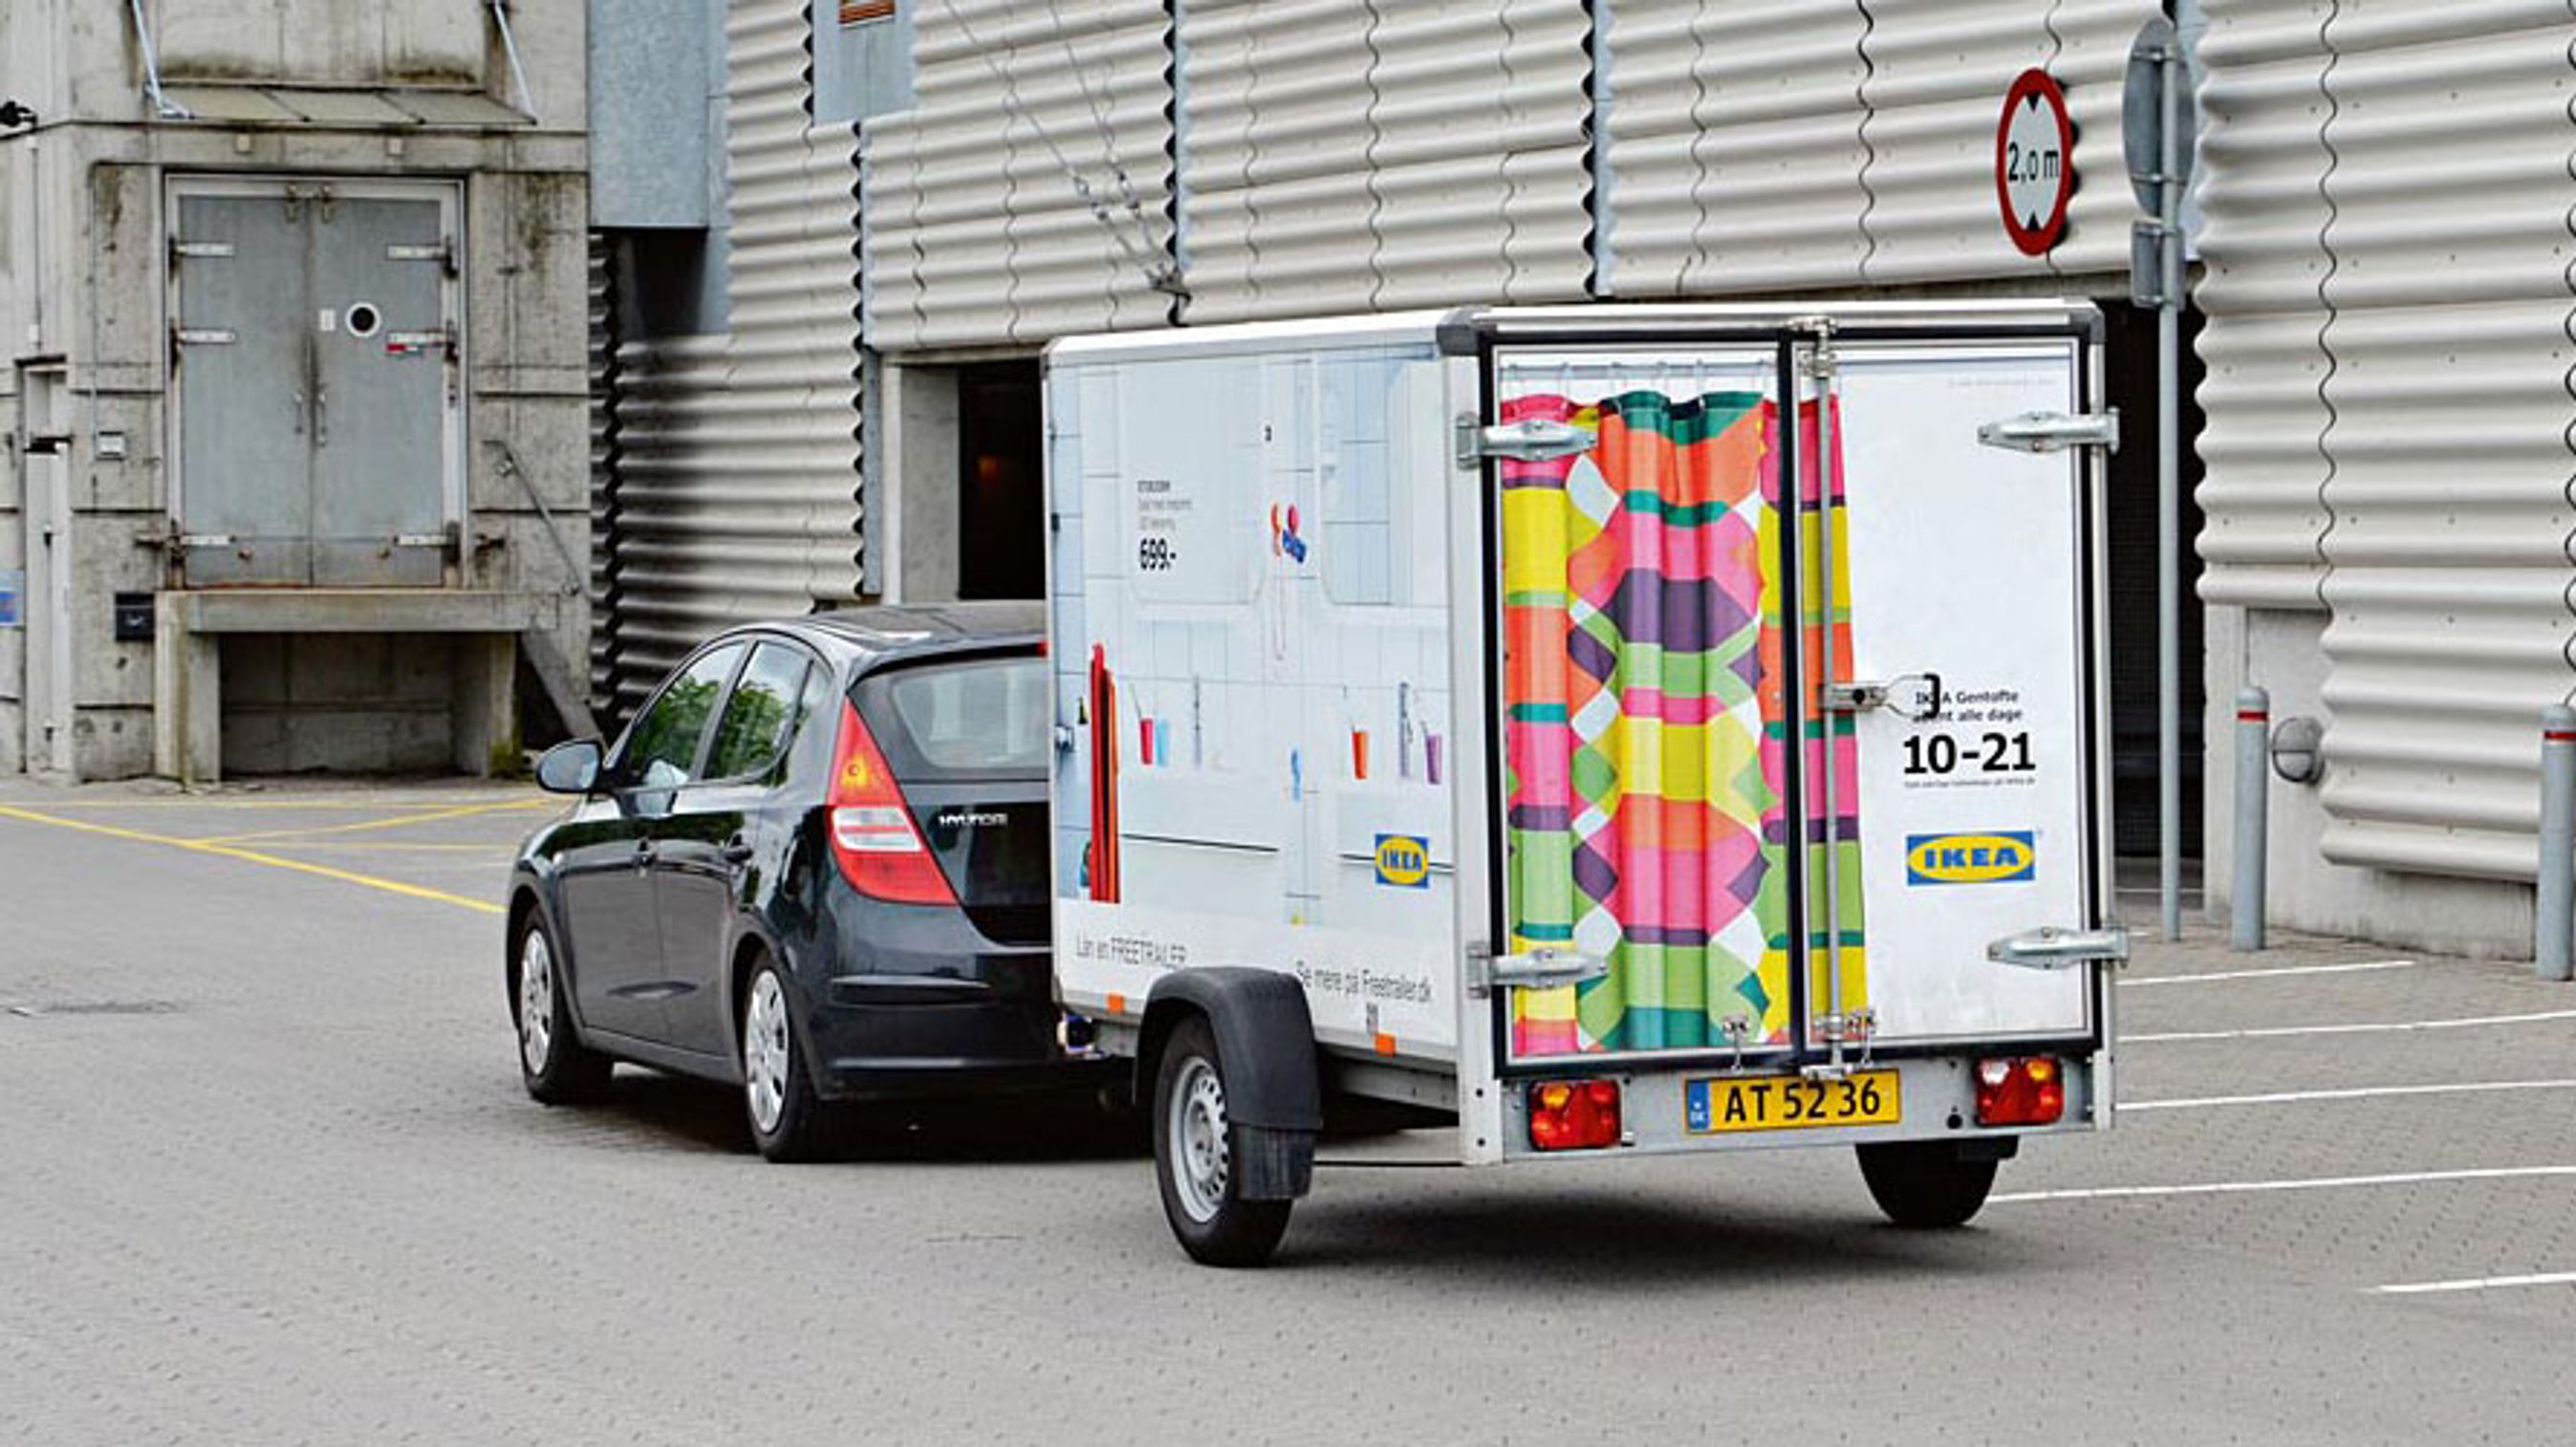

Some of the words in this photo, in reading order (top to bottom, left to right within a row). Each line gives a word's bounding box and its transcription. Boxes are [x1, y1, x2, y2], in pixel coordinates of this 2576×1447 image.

[2044, 149, 2059, 179] m
[1916, 691, 1952, 704] IKA
[1957, 689, 2019, 704] Gentofte
[1958, 709, 1983, 722] alle
[1987, 709, 2023, 724] dage
[1382, 849, 1422, 873] IKEA
[1924, 848, 2020, 869] IKEA
[1315, 968, 1341, 991] mere
[1724, 1085, 1772, 1123] AT
[1783, 1081, 1828, 1120] 52
[1837, 1077, 1881, 1117] 36
